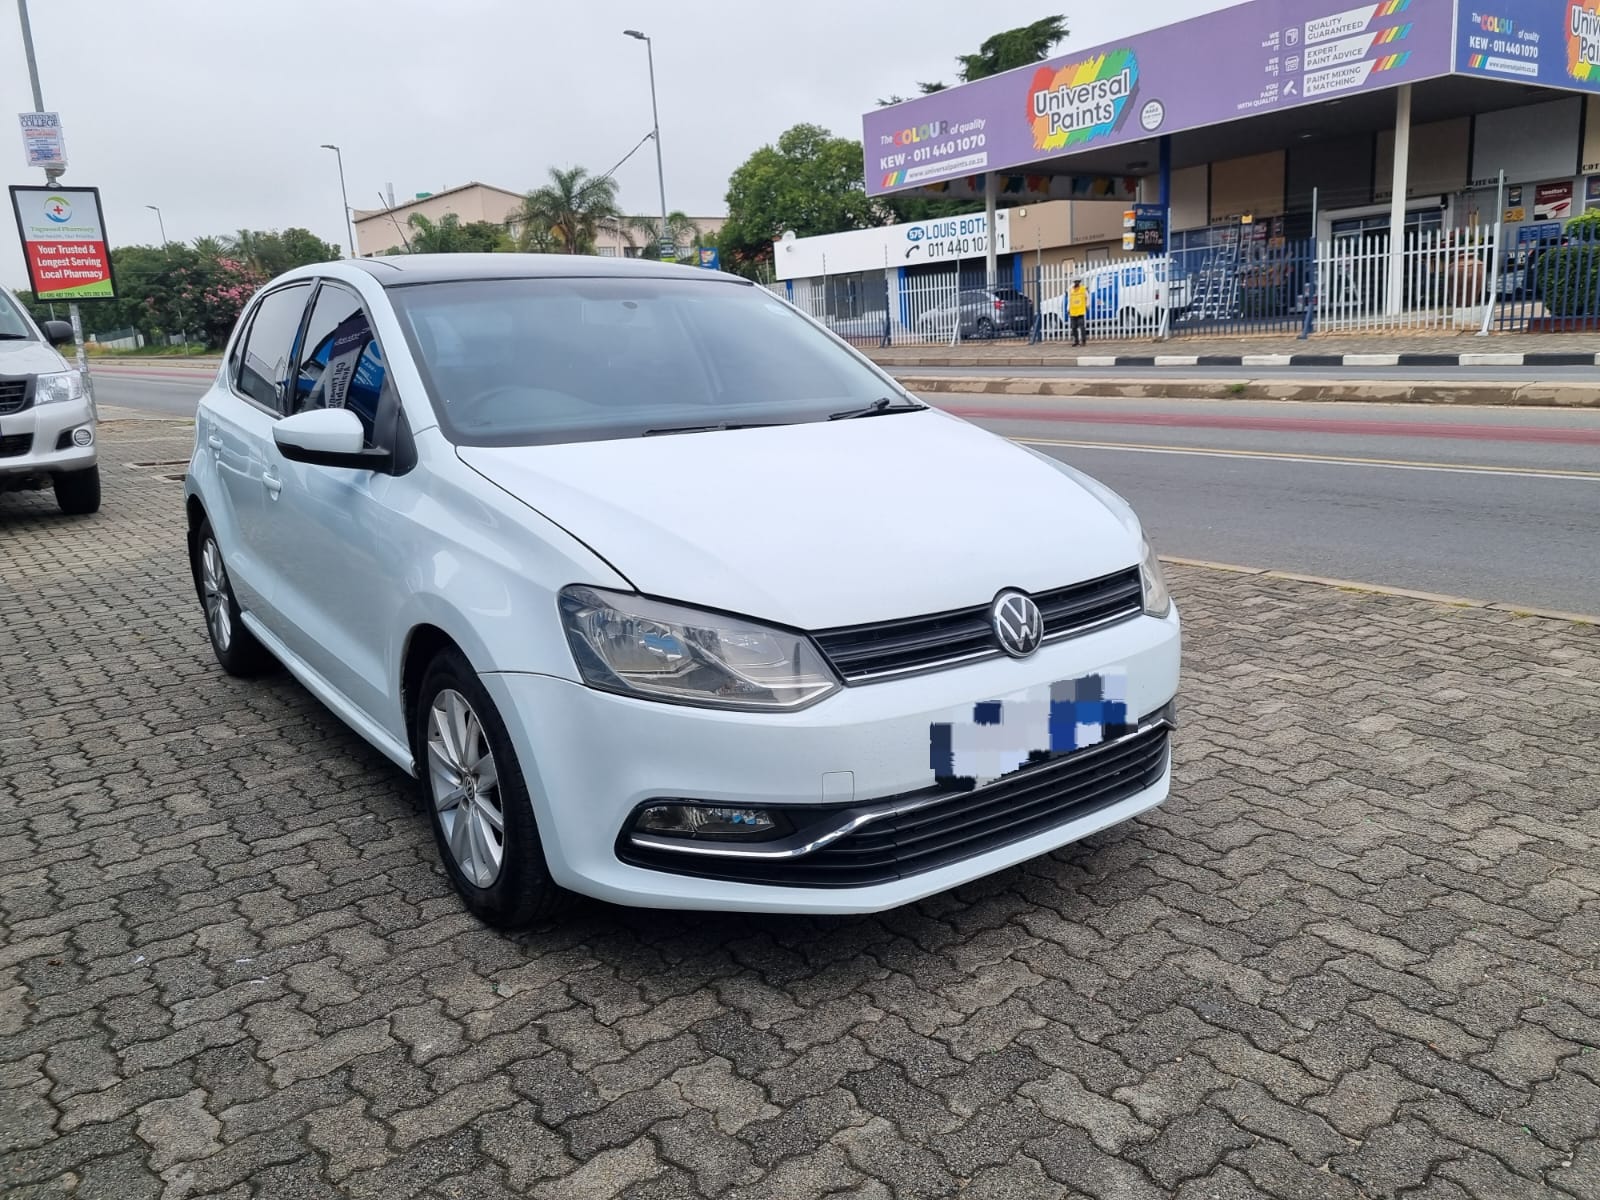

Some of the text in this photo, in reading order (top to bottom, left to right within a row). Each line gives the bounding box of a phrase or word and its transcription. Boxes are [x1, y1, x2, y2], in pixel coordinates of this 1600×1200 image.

[1308, 17, 1342, 32] QUALITY
[1472, 12, 1481, 24] The
[1573, 8, 1600, 36] Univ
[1307, 20, 1364, 40] GUARANTEED
[1307, 45, 1338, 58] EXPERT
[1470, 36, 1488, 50] KEW
[1493, 40, 1505, 53] 011
[1506, 42, 1520, 55] 440
[1521, 44, 1538, 58] 1070
[1307, 48, 1363, 67] PAINT ADVICE
[1307, 66, 1360, 84] PAINT MIXING
[1313, 77, 1355, 91] MATCHING
[1035, 71, 1129, 115] Universal
[1051, 102, 1113, 132] Paints
[881, 119, 986, 148] The COLOUR of quality
[880, 152, 905, 170] KEW
[914, 147, 930, 161] 011
[933, 142, 954, 156] 440
[957, 134, 986, 150] 1070
[926, 222, 957, 240] LOUIS
[960, 217, 988, 235] BOTH
[37, 245, 96, 254] Your Trusted &
[928, 242, 944, 257] 011
[947, 239, 969, 255] 440
[37, 257, 102, 268] Longest Serving
[40, 269, 103, 280] Local Pharmacy
